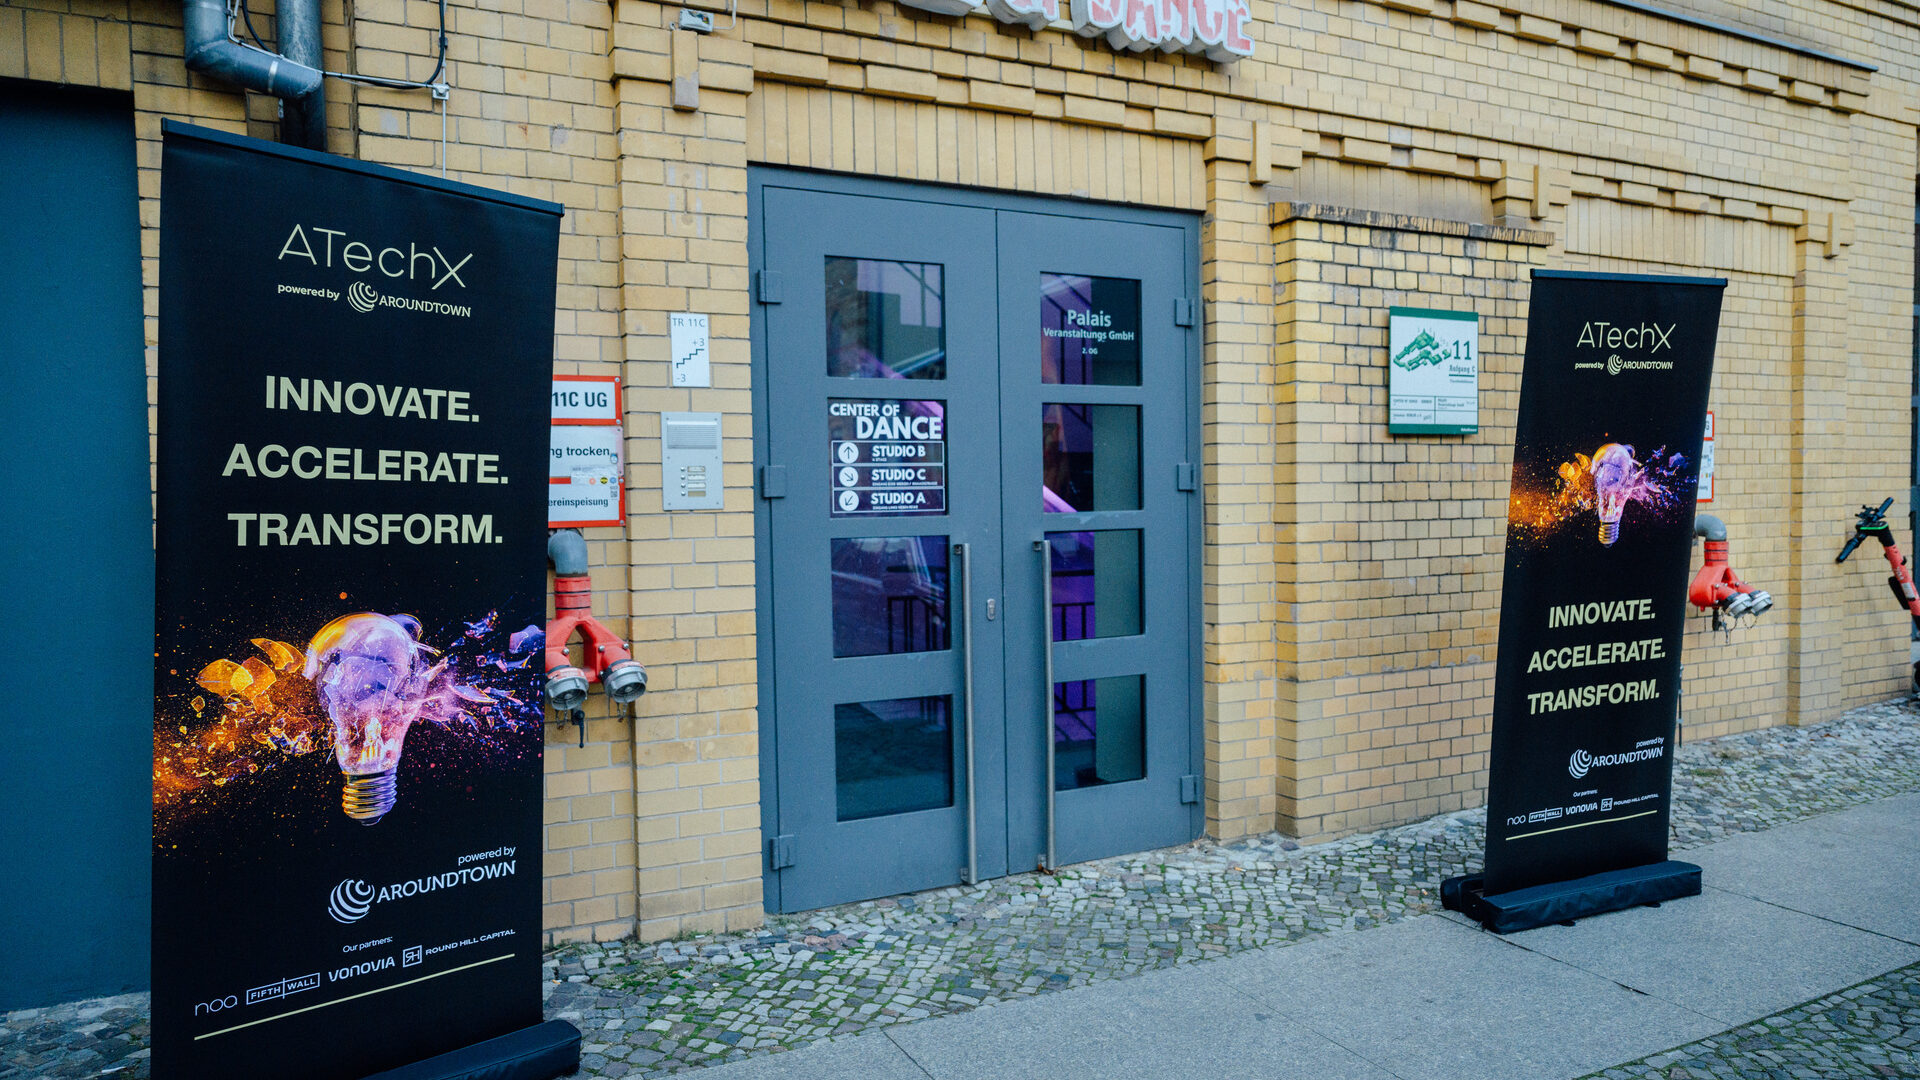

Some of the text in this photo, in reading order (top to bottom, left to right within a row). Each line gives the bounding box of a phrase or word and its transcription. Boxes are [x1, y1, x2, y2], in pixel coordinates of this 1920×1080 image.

[278, 223, 473, 290] ATechX
[277, 284, 471, 318] powered by AROUNDTOWN
[672, 318, 705, 328] TR 11C
[1067, 309, 1112, 327] Palais
[693, 338, 705, 347] +3
[1043, 327, 1135, 342] Veranstaltungs GmbH
[1576, 321, 1676, 354] ATechX
[1082, 347, 1088, 355] 2.
[1452, 340, 1472, 360] 11
[1575, 362, 1597, 370] powered
[1622, 361, 1673, 370] AROUNDTOWN
[677, 374, 686, 383] -3
[266, 375, 480, 423] INNOVATE.
[584, 391, 608, 407] UG
[829, 403, 900, 417] CENTER OF
[856, 416, 942, 440] DANCE
[566, 446, 610, 456] trocken
[872, 445, 926, 457] STUDIO B
[221, 443, 509, 484] ACCELERATE.
[871, 469, 926, 481] STUDIO C
[870, 492, 926, 505] STUDIO A
[227, 513, 503, 547] TRANSFORM.
[1549, 598, 1656, 629] INNOVATE.
[1527, 638, 1666, 673] ACCELERATE.
[1527, 679, 1660, 715] TRANSFORM.
[1636, 737, 1664, 749] powered by
[1592, 746, 1664, 768] AROUNDTOWN
[458, 846, 516, 866] powered by
[377, 860, 517, 903] AROUNDTOWN
[342, 936, 393, 953] Our partners:
[195, 995, 237, 1016] noa
[250, 986, 281, 1000] FIFTH
[287, 978, 315, 990] WALL
[425, 942, 458, 956] ROUND
[459, 937, 479, 947] HILL
[480, 928, 516, 942] CAPITAL
